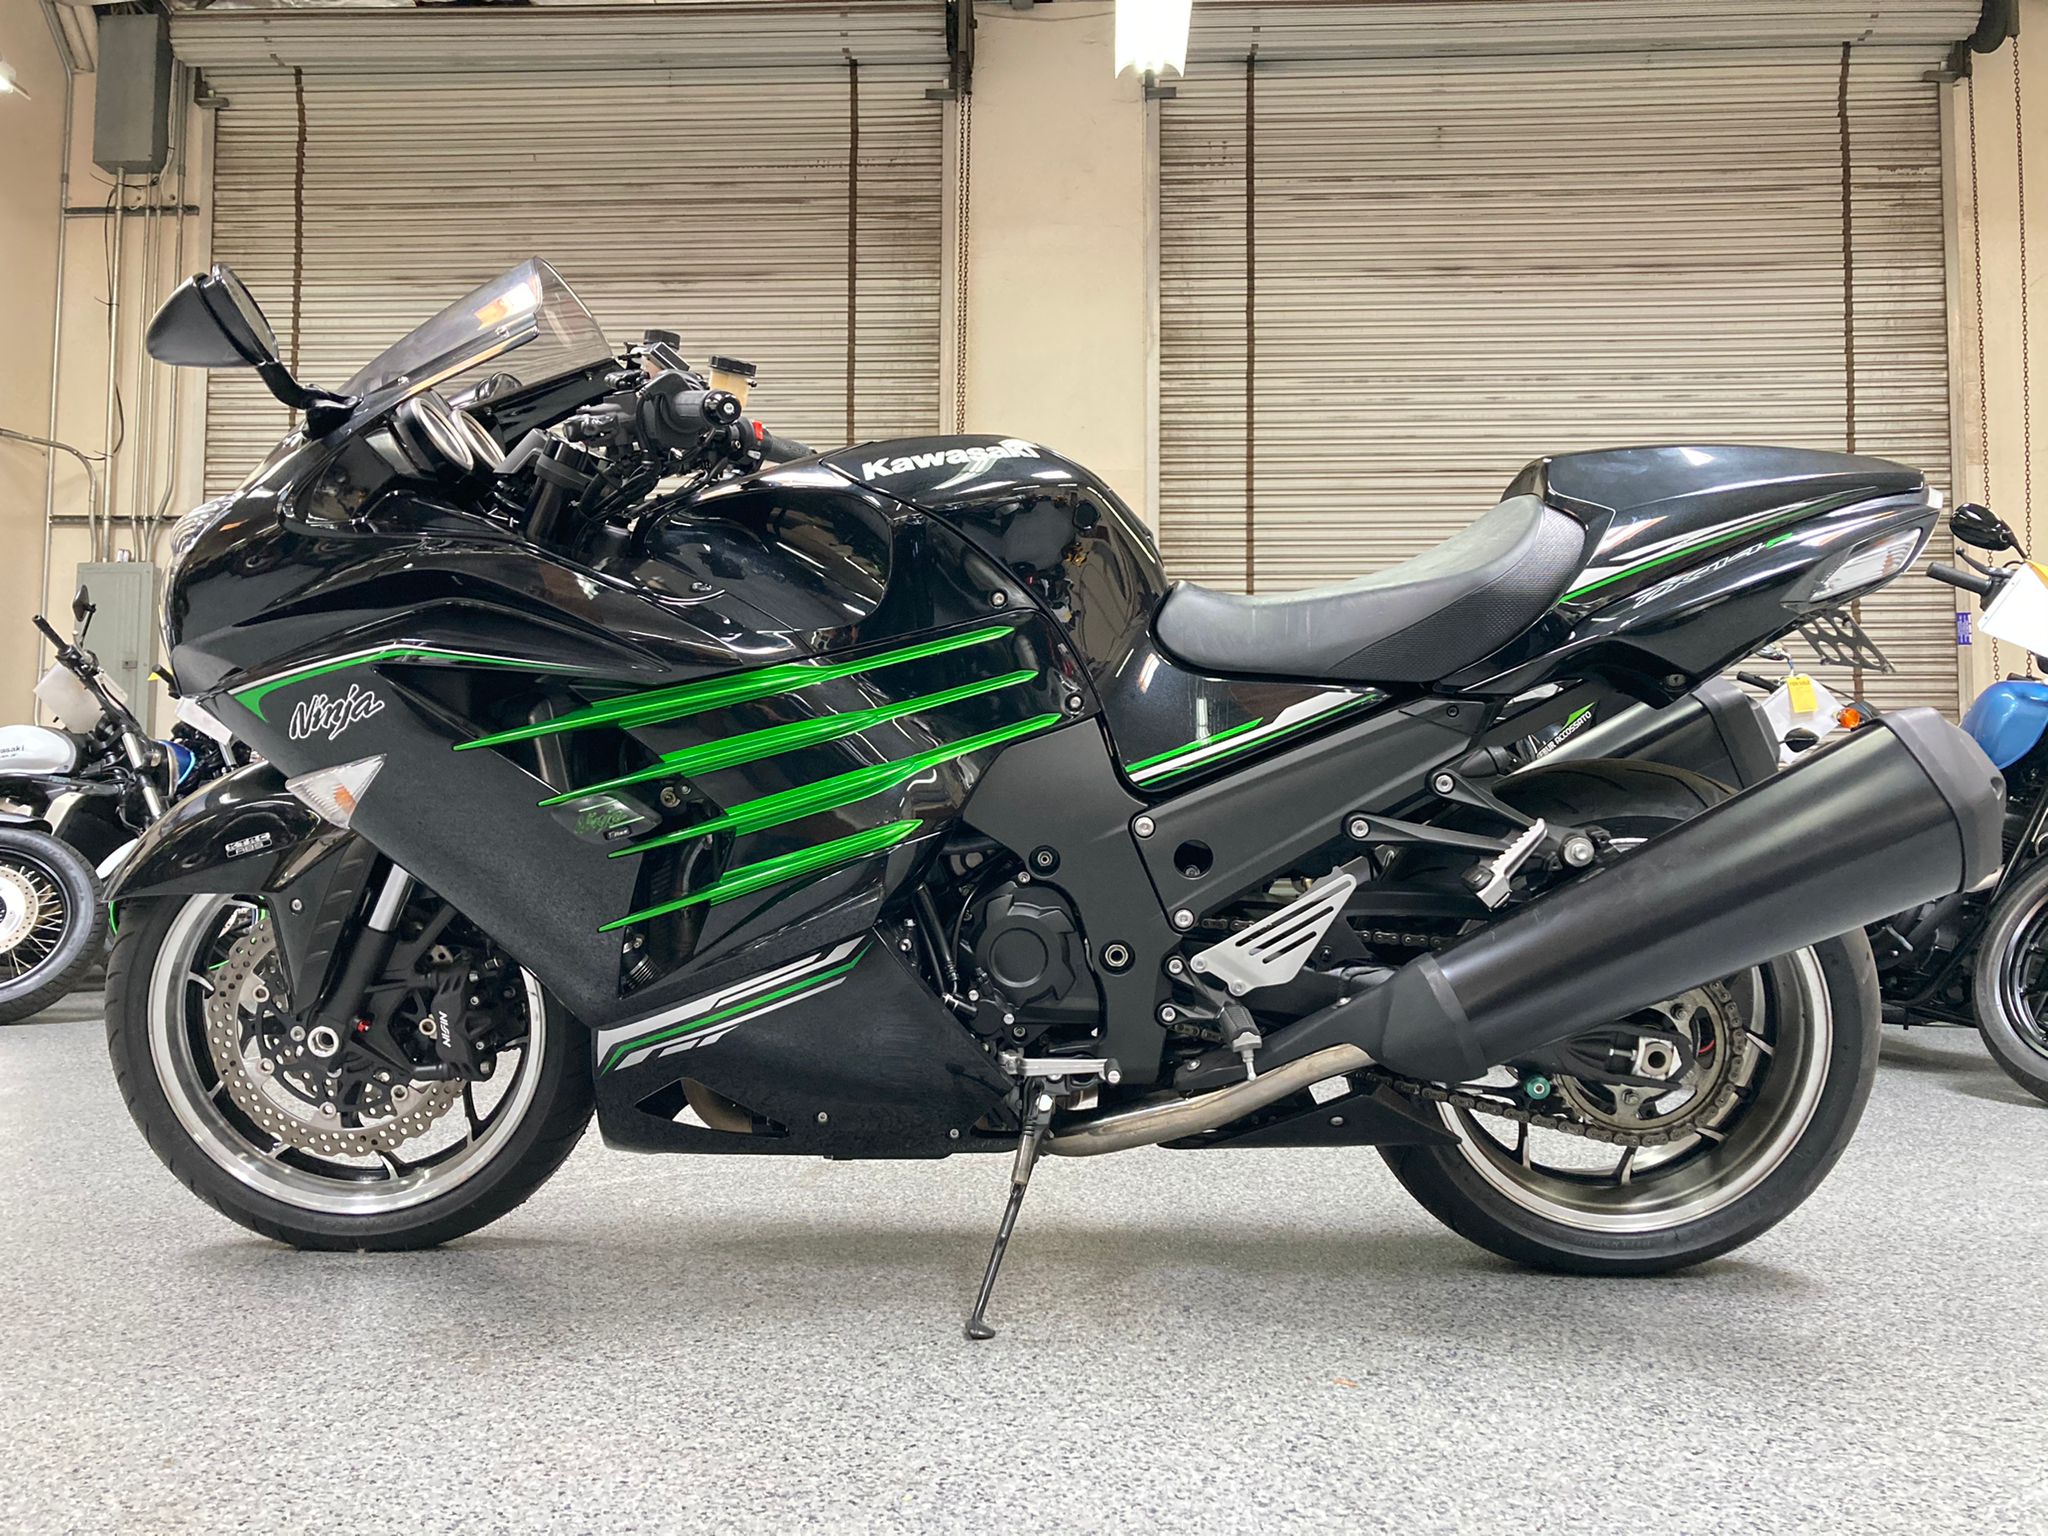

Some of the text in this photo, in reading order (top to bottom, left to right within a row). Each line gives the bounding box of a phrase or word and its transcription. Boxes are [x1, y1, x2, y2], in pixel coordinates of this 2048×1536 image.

[862, 439, 1040, 481] Kawasaki
[289, 684, 385, 740] Ninja
[1554, 711, 1592, 744] ACCOSSATO
[438, 1010, 452, 1048] NISSIN
